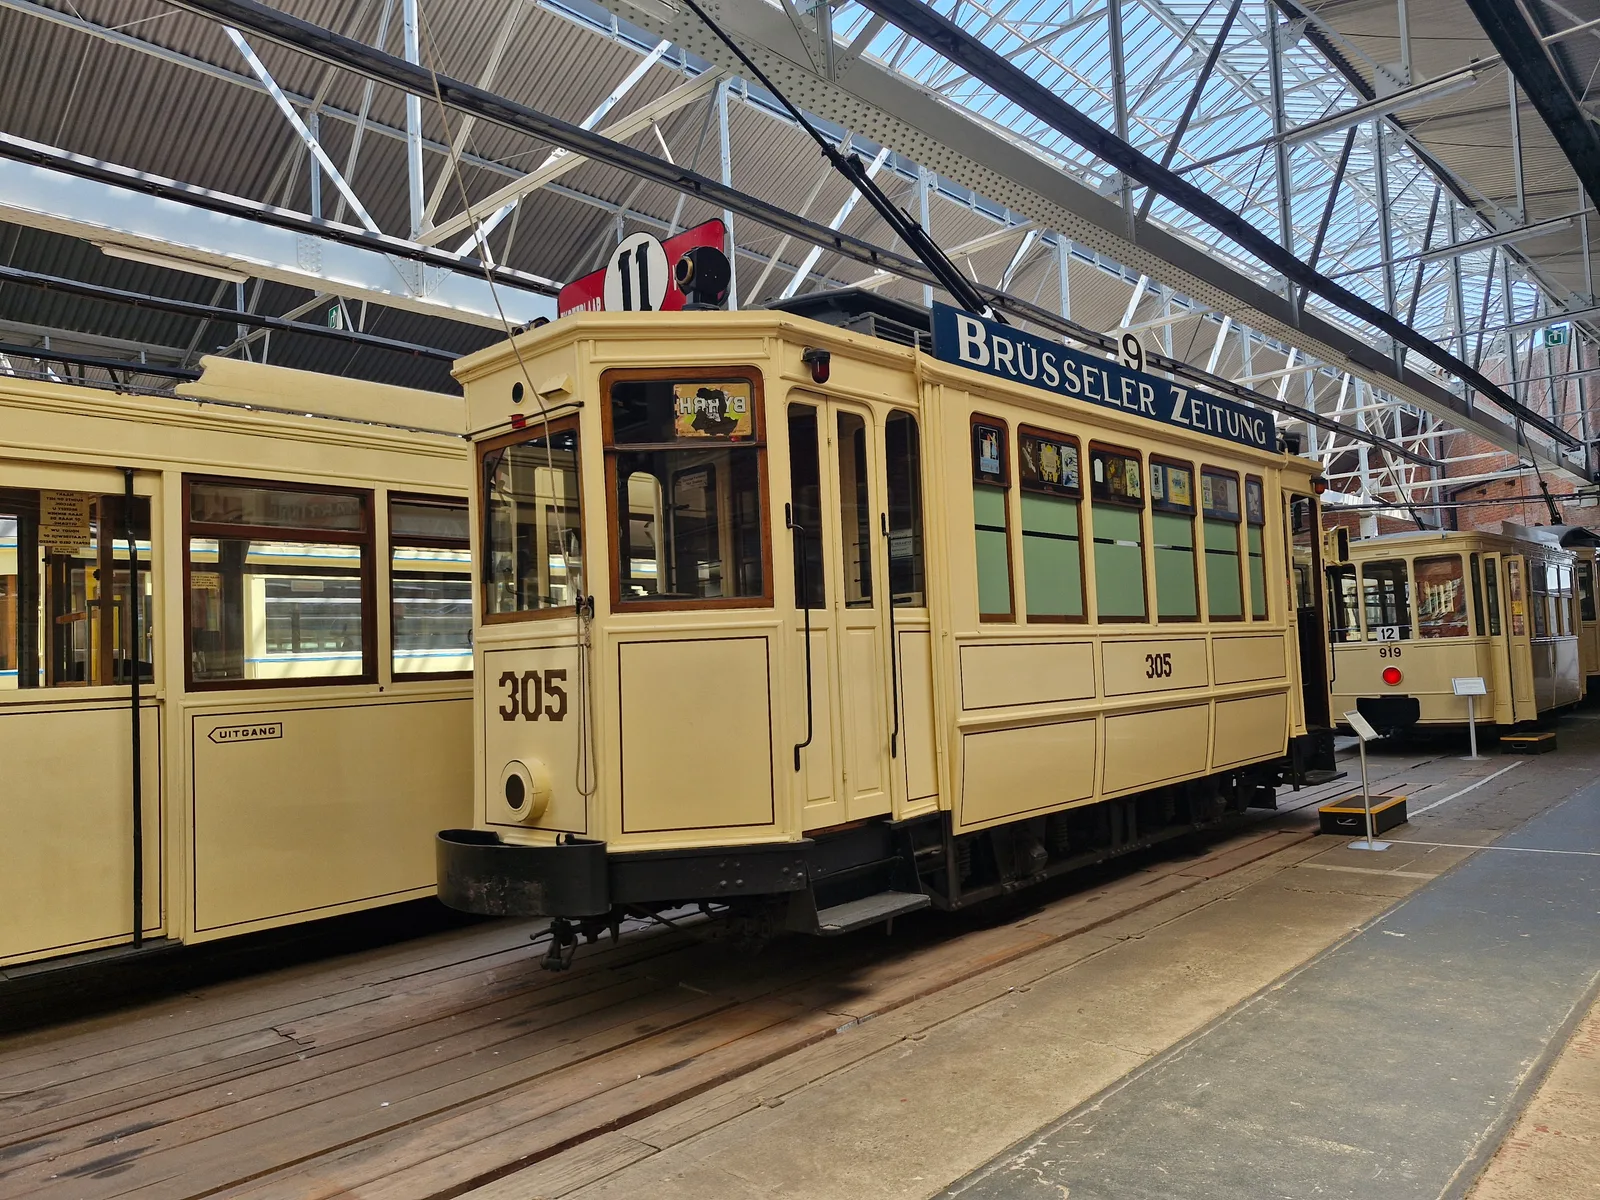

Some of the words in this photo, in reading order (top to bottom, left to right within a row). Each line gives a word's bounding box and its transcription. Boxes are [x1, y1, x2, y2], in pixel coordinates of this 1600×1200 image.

[617, 241, 653, 311] 11
[1122, 333, 1143, 372] 9
[955, 312, 1157, 416] BRÜSSELER
[1169, 384, 1266, 445] ZEITUNG
[1381, 628, 1395, 640] 12
[1145, 653, 1172, 679] 305
[1379, 647, 1402, 658] 919
[498, 669, 568, 722] 305
[219, 727, 276, 739] UITGANG
